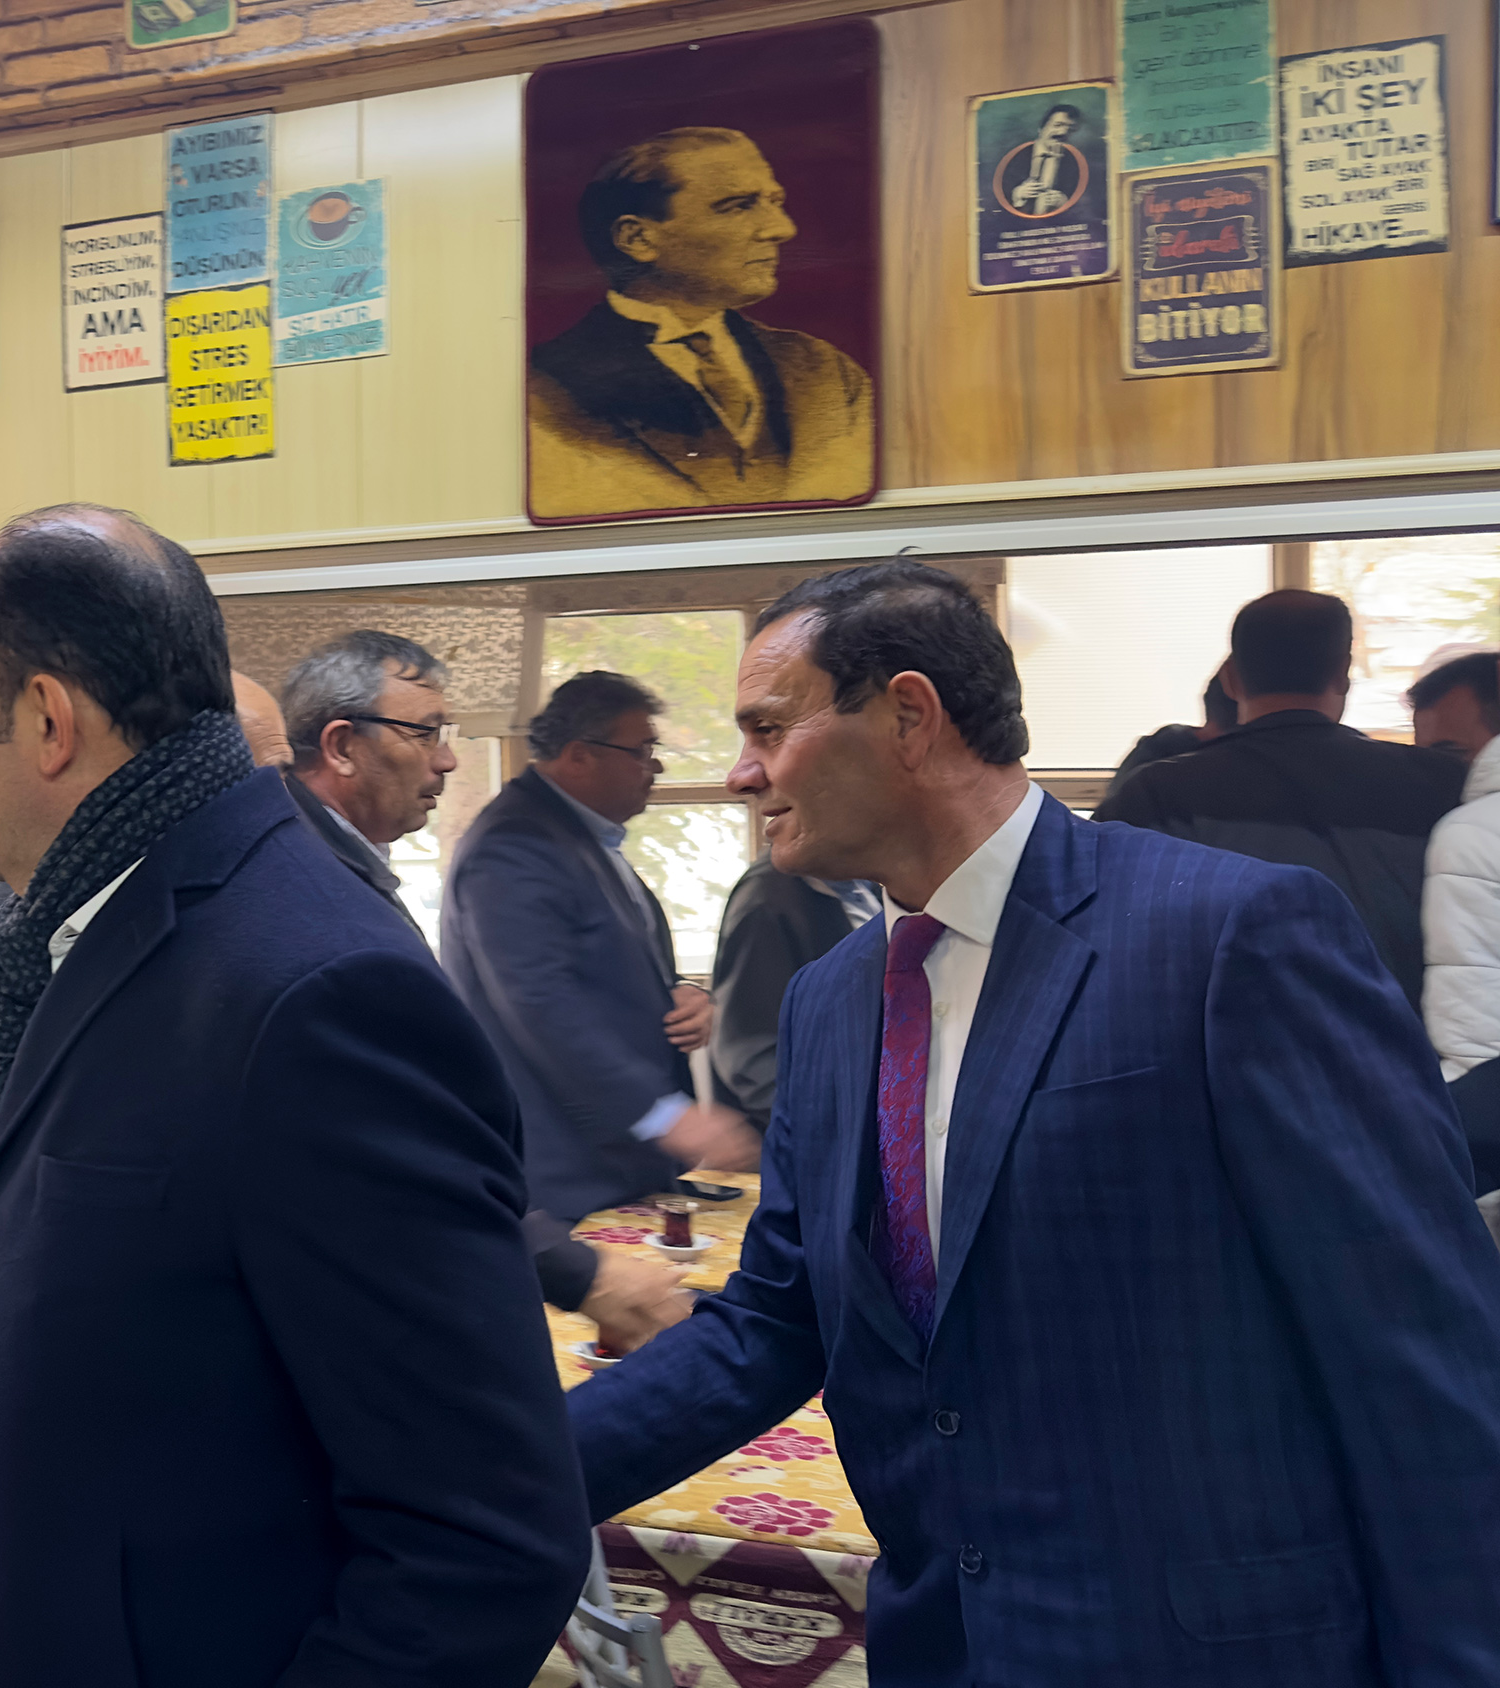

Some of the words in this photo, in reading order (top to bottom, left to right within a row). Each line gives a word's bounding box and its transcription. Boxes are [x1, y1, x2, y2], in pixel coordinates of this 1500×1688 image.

[1317, 54, 1405, 84] İNSANI
[1300, 80, 1345, 118] İKİ
[1356, 78, 1426, 117] ŞEY
[1298, 118, 1393, 144] AYAKTA
[1344, 134, 1432, 160] TUTAR
[191, 157, 261, 184] VARSA
[1337, 162, 1377, 181] SAĞ
[1380, 158, 1432, 175] AYAK
[1300, 193, 1340, 209] SOL
[1342, 187, 1396, 204] AYAK
[172, 248, 264, 278] DÜŞÜNÜN
[81, 308, 146, 339] AMA
[169, 306, 270, 342] DIŞARIDAN
[320, 304, 371, 328] HATIR
[1138, 302, 1267, 343] BİTİYOR
[78, 344, 150, 373] İYİYİM.
[190, 344, 249, 371] STRES
[171, 377, 269, 408] GETİRMEK
[173, 413, 268, 443] YASAKTIR!
